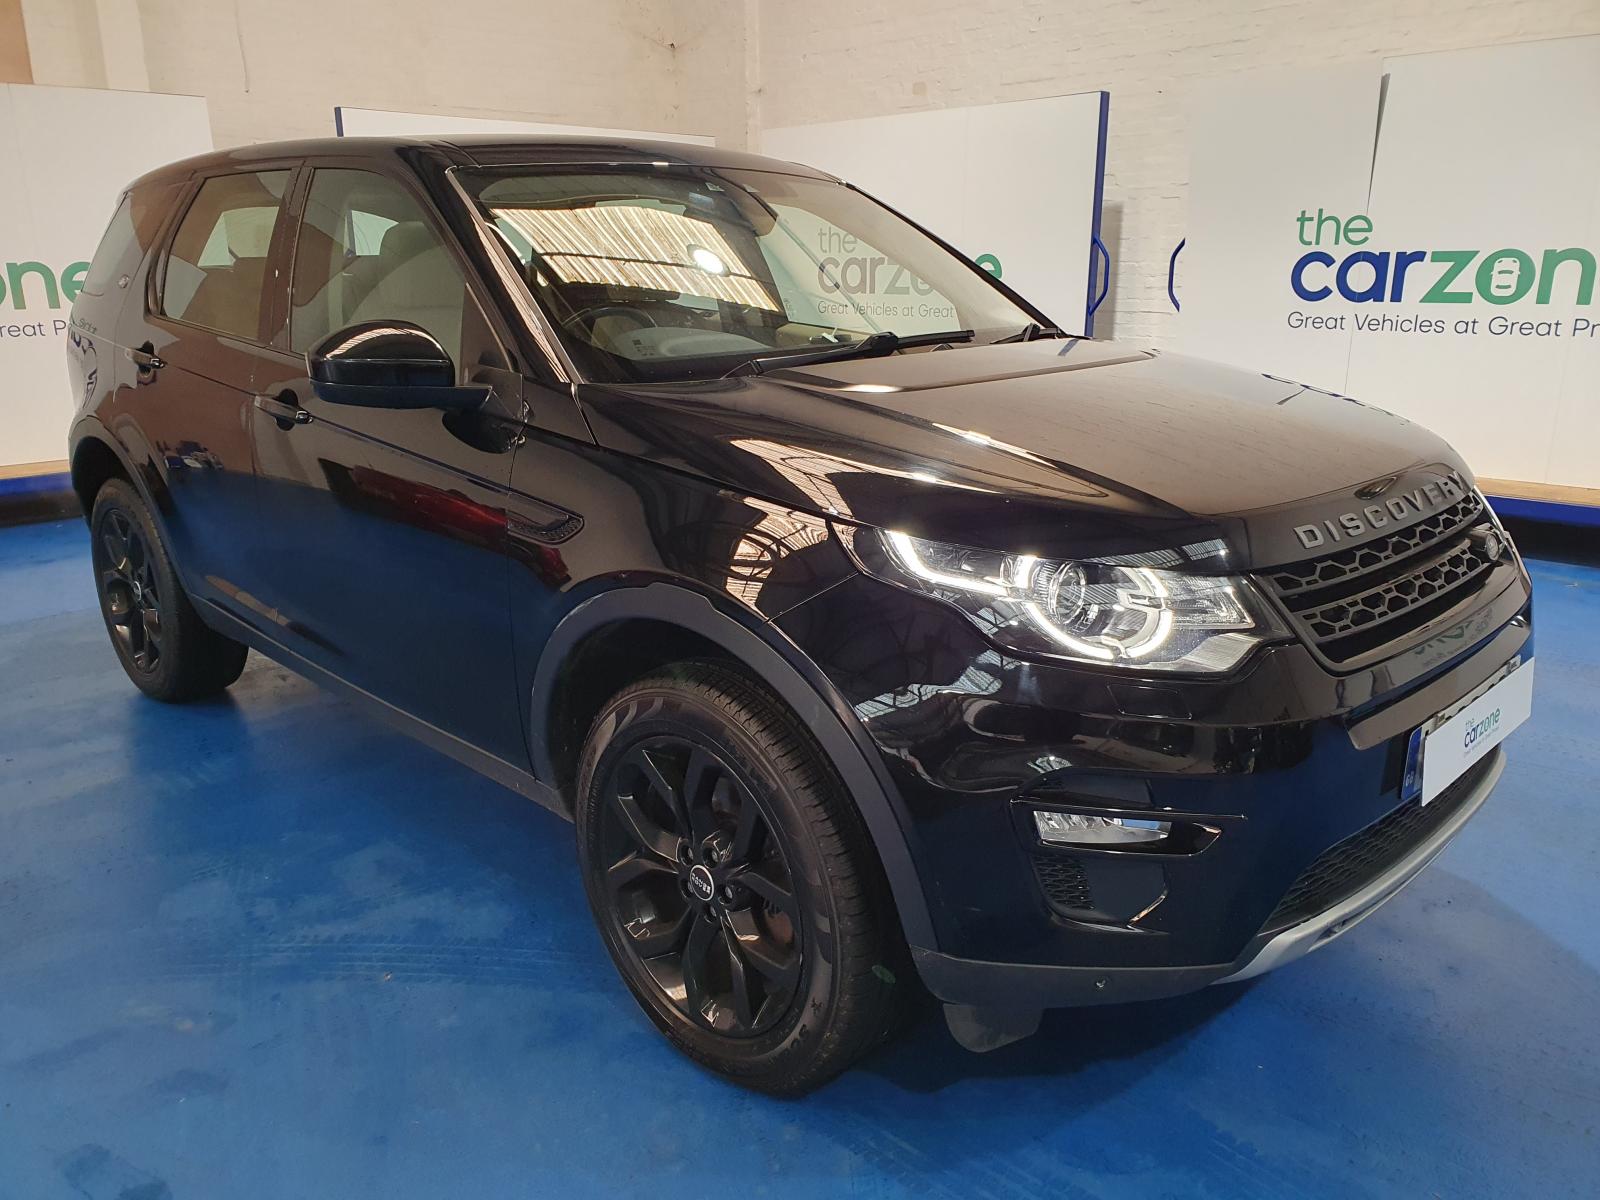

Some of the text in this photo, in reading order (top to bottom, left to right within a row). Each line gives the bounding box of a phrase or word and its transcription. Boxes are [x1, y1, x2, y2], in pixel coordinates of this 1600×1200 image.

[818, 226, 858, 254] the
[1296, 208, 1374, 246] the
[1291, 247, 1600, 305] carzon
[818, 301, 954, 318] Great Vehicles at Great
[1287, 311, 1346, 330] Great
[1354, 313, 1445, 334] Vehicles
[1454, 317, 1479, 335] at
[1488, 316, 1562, 337] Great
[1293, 471, 1467, 549] DISCOVERY
[1464, 707, 1501, 748] carzone
